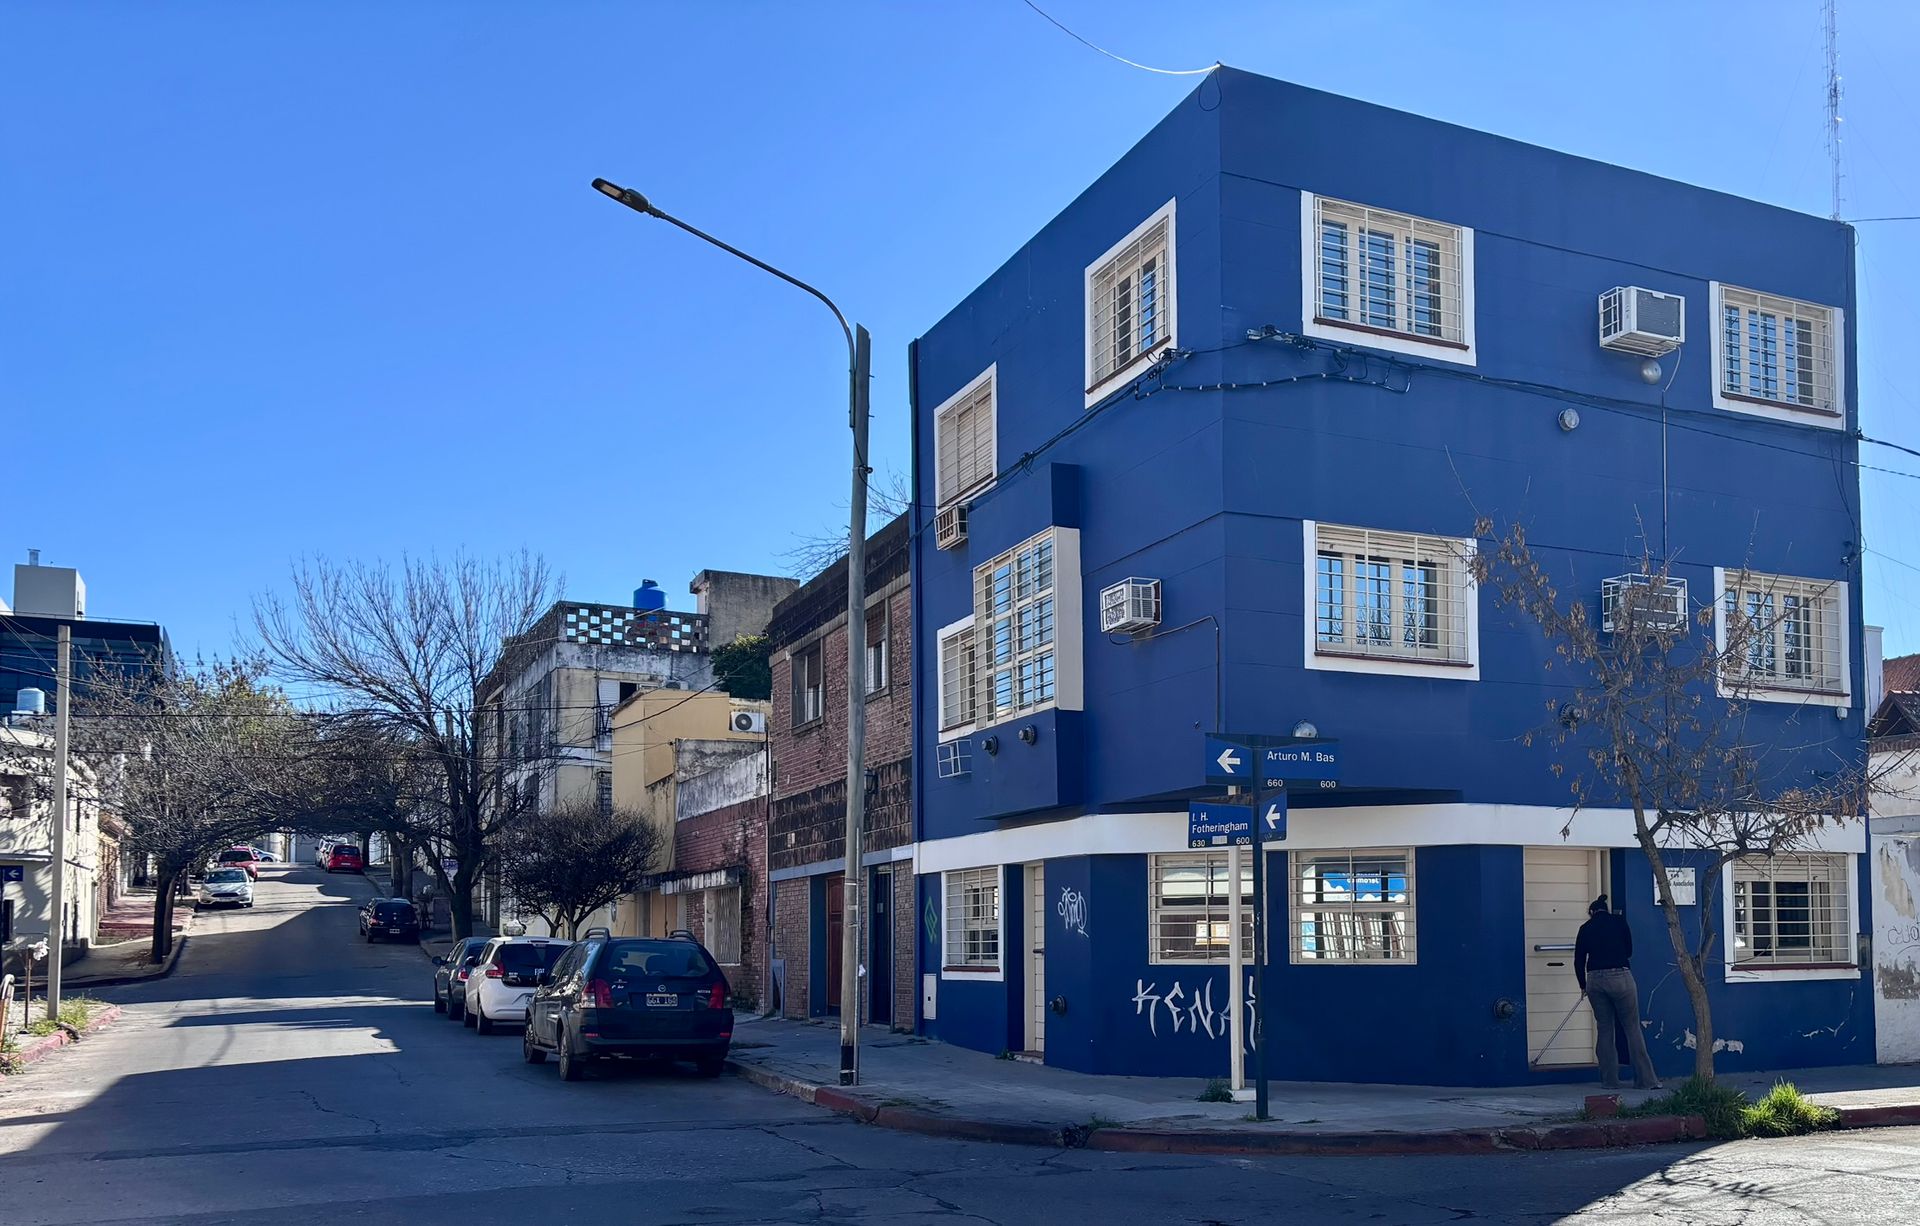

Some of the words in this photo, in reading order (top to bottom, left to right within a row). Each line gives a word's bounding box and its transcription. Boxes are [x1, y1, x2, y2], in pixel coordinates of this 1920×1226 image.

[1267, 751, 1298, 762] Arturo
[1301, 751, 1312, 762] M.
[1316, 752, 1335, 763] Bas
[1267, 779, 1284, 787] 660
[1320, 780, 1336, 789] 600
[1200, 812, 1209, 821] H.
[1192, 822, 1248, 834] Fotheringham
[1192, 839, 1206, 847] 630
[1236, 837, 1250, 845] 600
